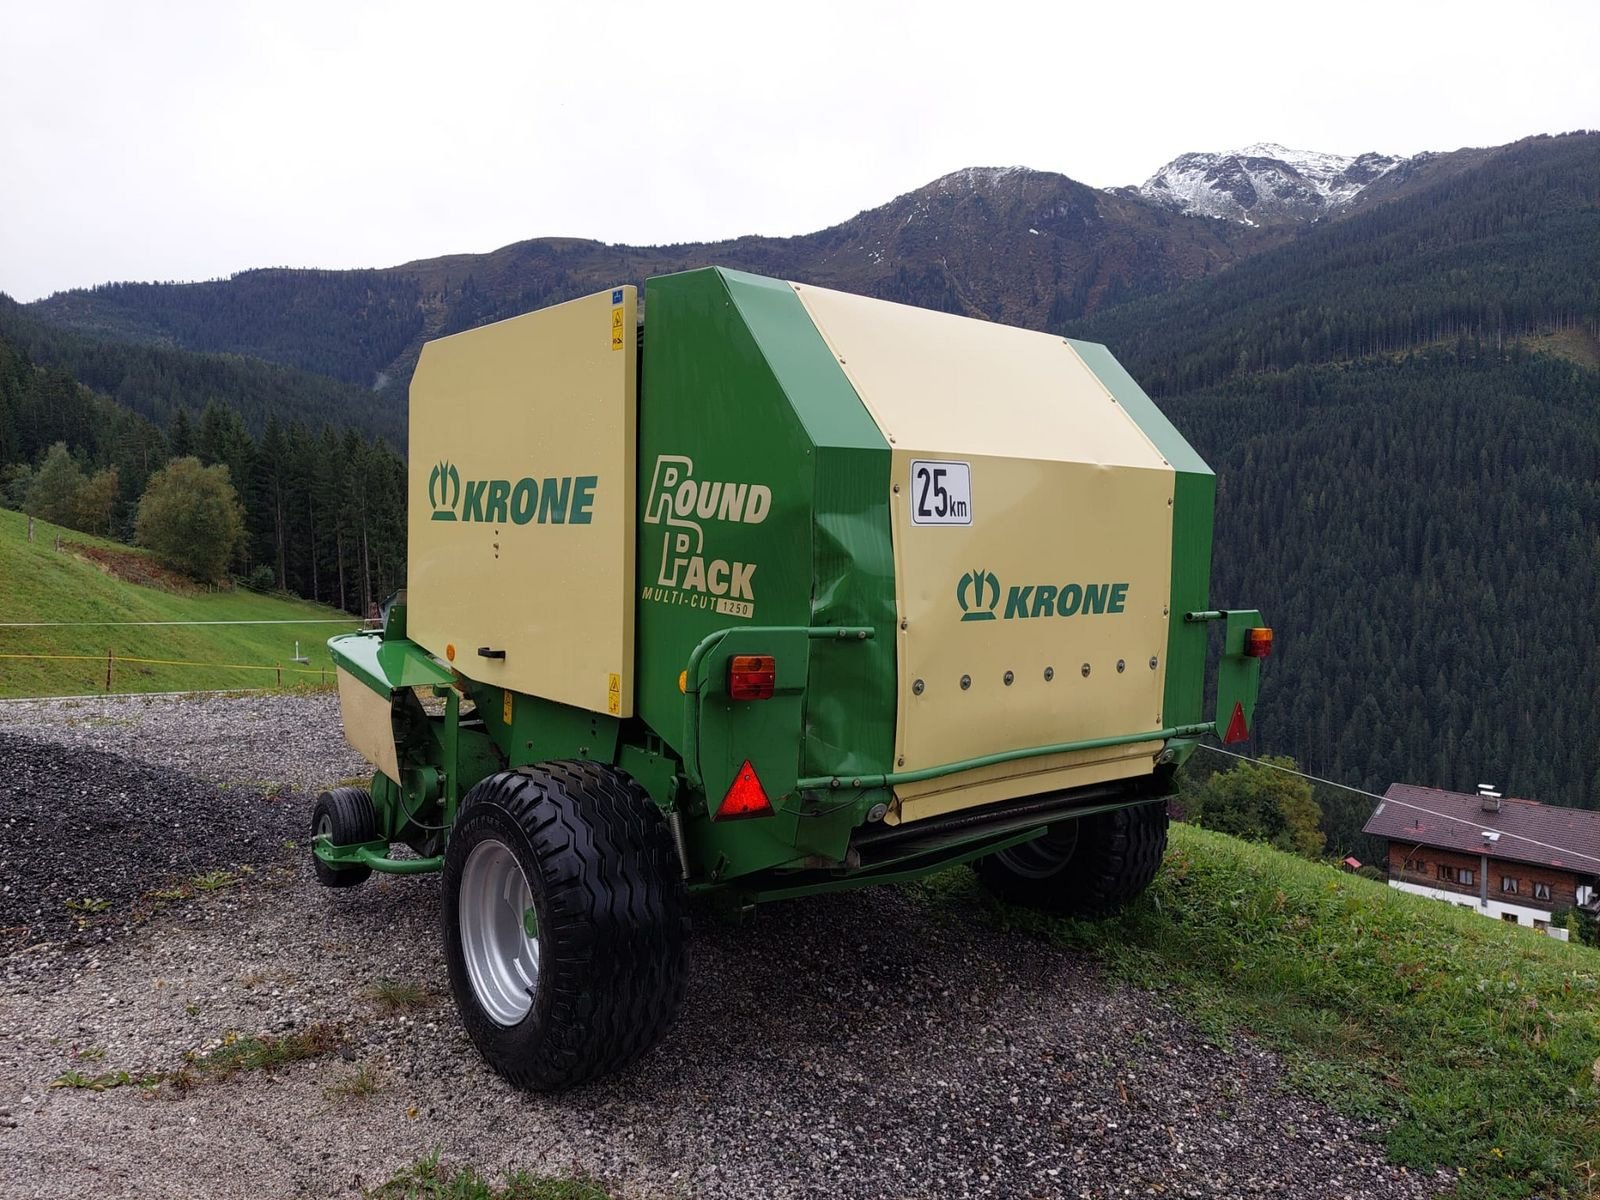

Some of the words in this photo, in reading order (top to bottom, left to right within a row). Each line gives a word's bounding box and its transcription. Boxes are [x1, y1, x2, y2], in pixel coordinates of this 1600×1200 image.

[462, 476, 598, 525] KRONE
[644, 455, 772, 524] ROUND
[658, 524, 757, 600] PACK
[642, 587, 716, 611] MULTI-CUT
[723, 601, 749, 616] 1250
[1003, 583, 1130, 620] KRONE
